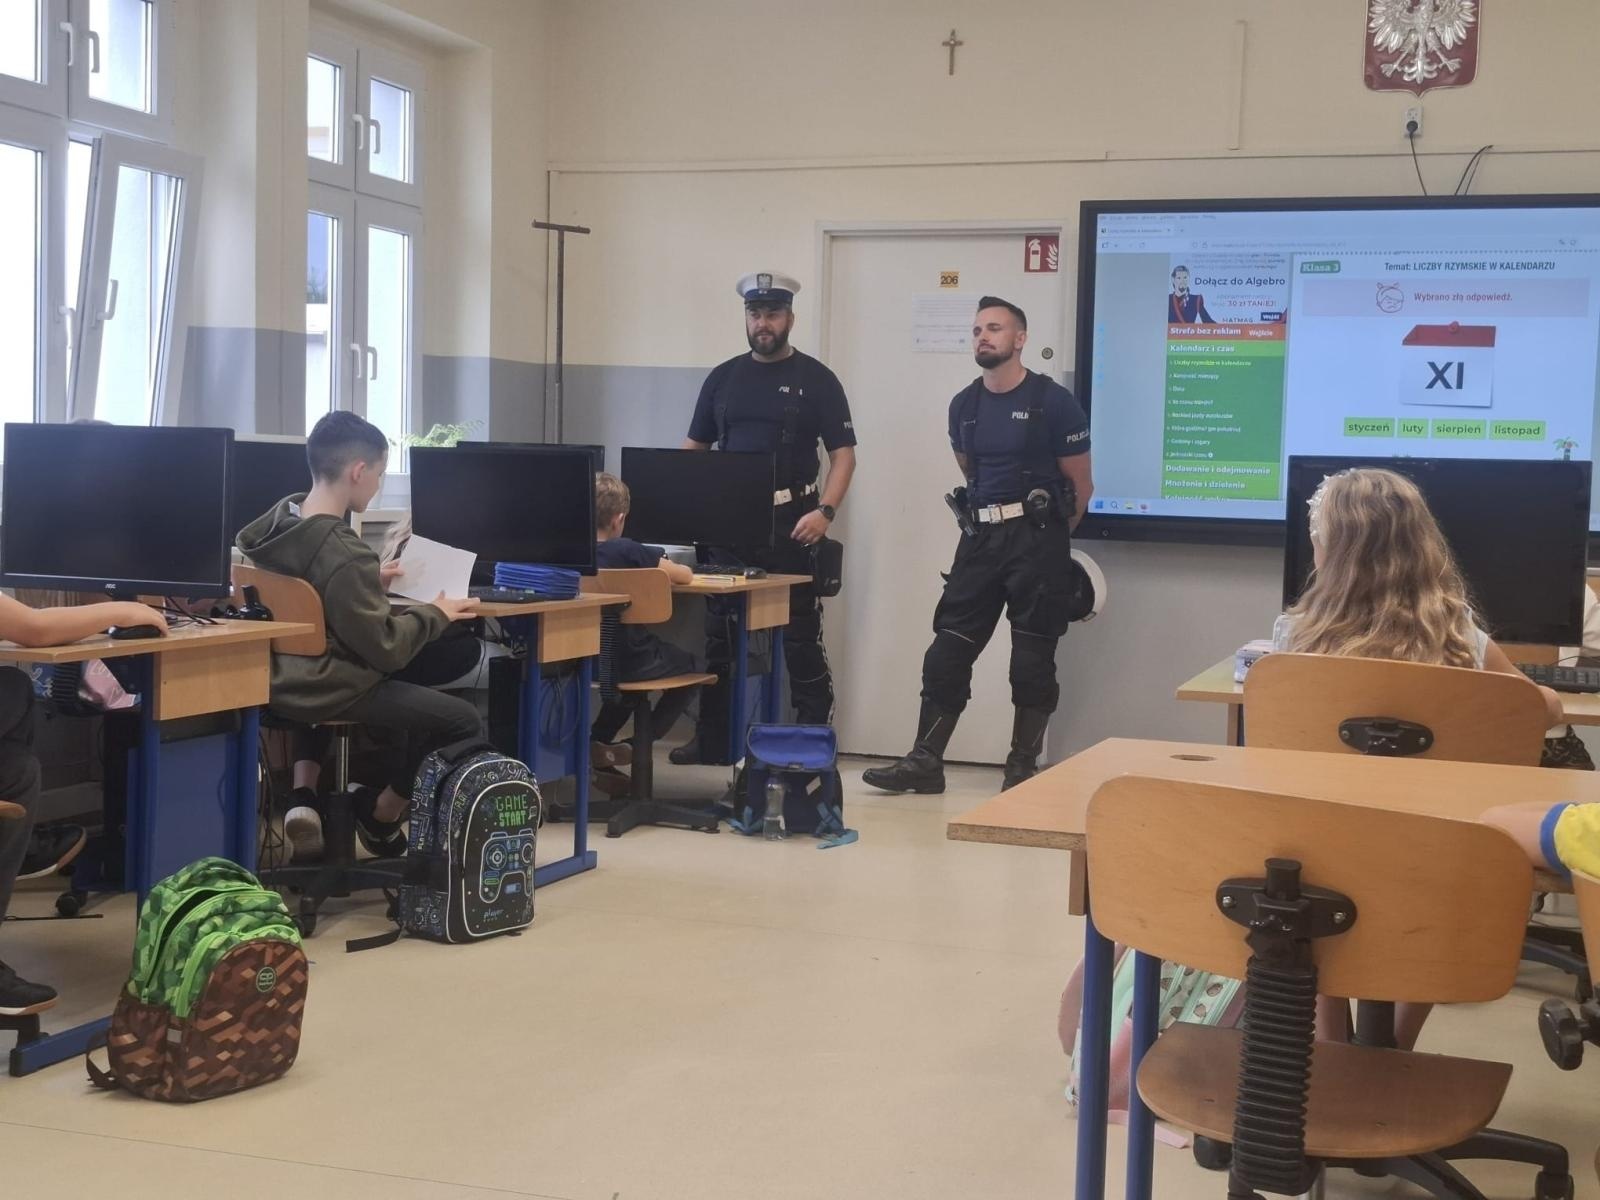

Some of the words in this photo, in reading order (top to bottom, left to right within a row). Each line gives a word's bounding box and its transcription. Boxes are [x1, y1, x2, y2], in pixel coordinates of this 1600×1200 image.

[1302, 263, 1331, 272] Klasa
[1385, 262, 1411, 271] Temat:
[1413, 262, 1442, 271] LICZBY
[1444, 261, 1488, 271] RZYMSKIE
[1489, 261, 1498, 270] W
[1499, 261, 1556, 271] KALENDARZU
[940, 275, 959, 285] 206
[1194, 277, 1228, 287] Dołącz
[1230, 277, 1244, 286] do
[1245, 277, 1286, 287] Algebro
[1414, 291, 1450, 303] Wybrano
[1170, 327, 1196, 336] Strefa
[1197, 327, 1212, 336] bez
[1213, 327, 1242, 336] reklam
[1170, 344, 1210, 353] Kalendarz
[1216, 345, 1235, 353] czas
[1424, 361, 1465, 390] XI
[1348, 423, 1390, 433] styczeń
[1402, 423, 1424, 434] luty
[1436, 424, 1482, 435] sierpień
[1494, 425, 1541, 436] listopad
[1166, 464, 1210, 473] Dodawanie
[1216, 466, 1271, 475] odejmowanie
[1165, 479, 1203, 488] Mnożenie
[1209, 480, 1246, 489] dzielenie
[495, 794, 528, 812] GAME
[499, 810, 527, 827] START
